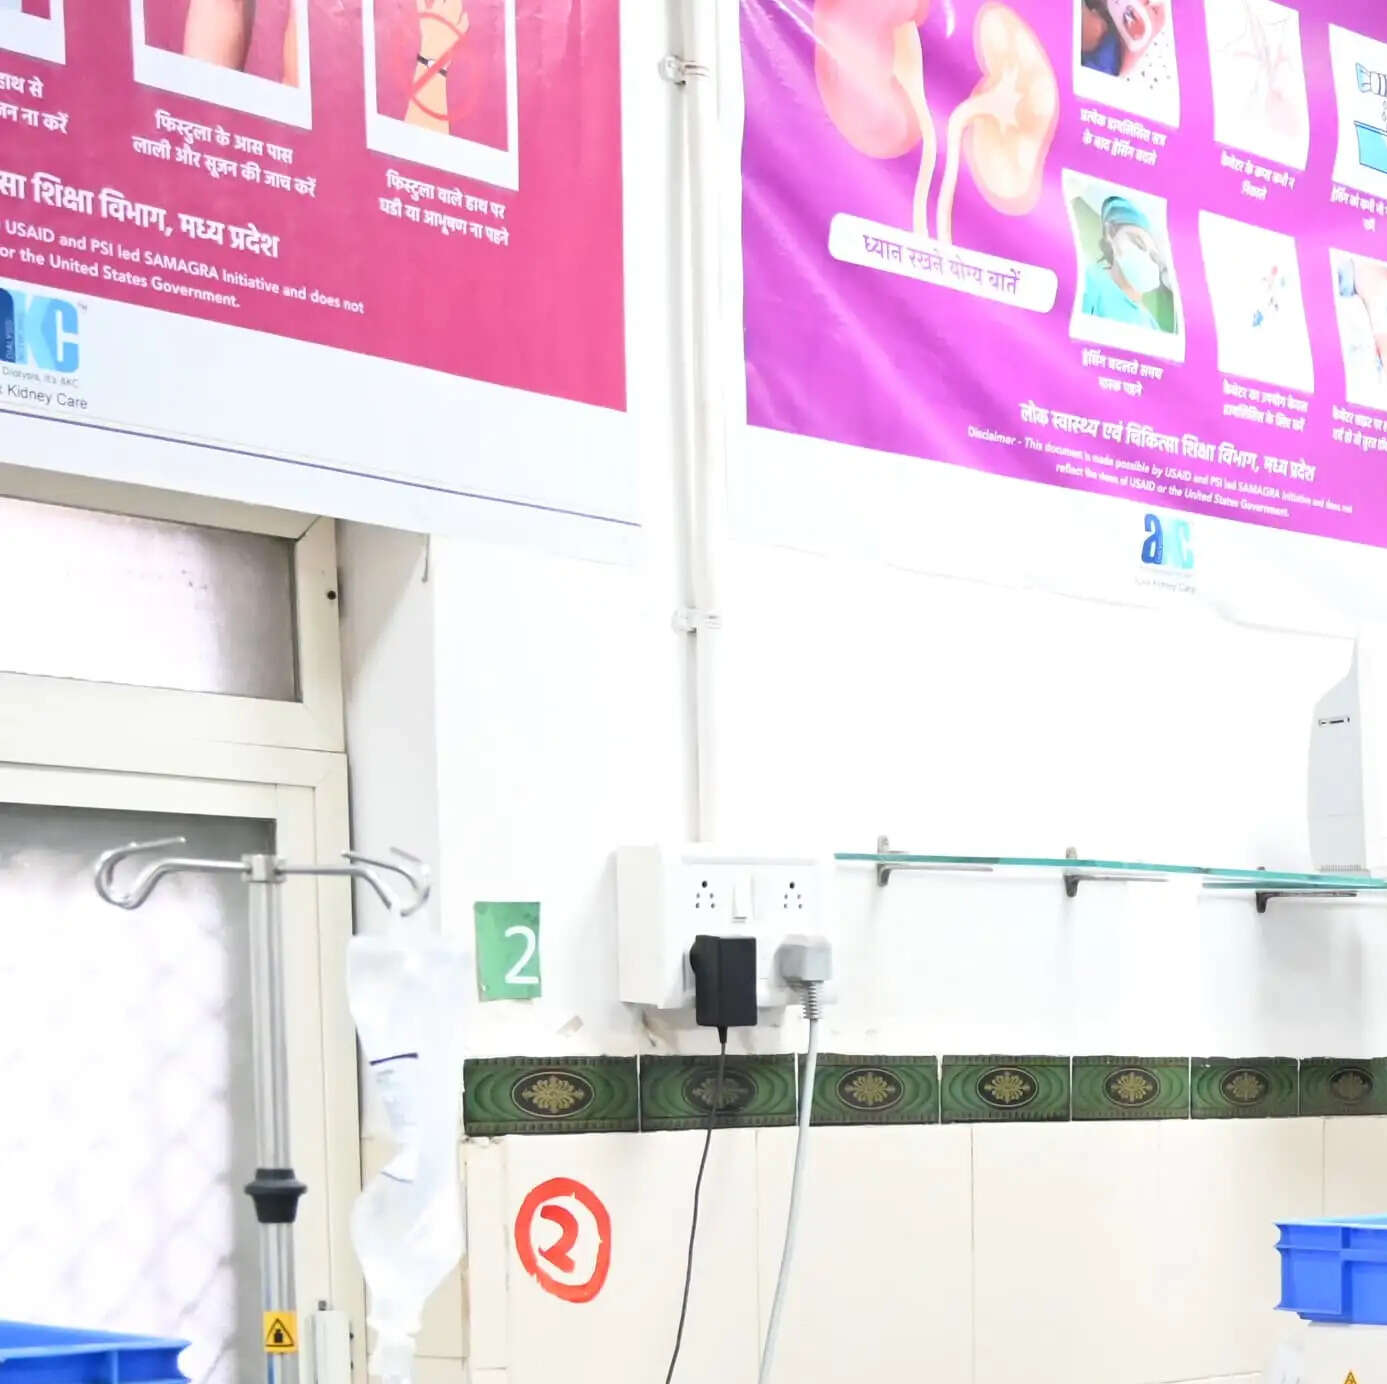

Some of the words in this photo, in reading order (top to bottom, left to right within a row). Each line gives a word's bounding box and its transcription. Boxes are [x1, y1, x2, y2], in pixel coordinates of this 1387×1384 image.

[27, 75, 44, 98] से
[20, 108, 39, 127] ना
[41, 112, 69, 134] करें
[155, 108, 211, 144] फिस्टुला
[215, 125, 230, 145] के
[234, 134, 264, 156] आस
[266, 143, 293, 164] पास
[132, 136, 171, 160] लाली
[175, 143, 201, 168] और
[204, 154, 237, 179] सूजन
[240, 161, 261, 183] की
[294, 177, 316, 197] करें
[385, 169, 434, 201] फिस्टुला
[437, 187, 462, 208] वाले
[465, 195, 488, 214] हाथ
[490, 201, 506, 219] पर
[31, 171, 94, 215] शिक्षा
[99, 187, 174, 237] विभाग,
[178, 213, 225, 245] मध्य
[228, 222, 280, 258] प्रदेश
[404, 204, 420, 222] या
[424, 209, 467, 235] आभूषण
[470, 222, 483, 238] ना
[5, 220, 55, 243] USAID
[59, 235, 87, 250] and
[90, 239, 113, 257] PSI
[118, 244, 140, 262] led
[144, 251, 219, 280] SAMAGRA
[223, 269, 279, 294] Initiative
[283, 286, 307, 300] and
[310, 290, 341, 308] does
[343, 300, 365, 314] not
[20, 248, 45, 265] the
[50, 254, 99, 277] United
[103, 265, 147, 287] States
[151, 276, 240, 308] Government.
[863, 235, 903, 262] ध्यान
[907, 247, 944, 275] रखने
[948, 253, 982, 284] योग्य
[987, 268, 1020, 295] बातें
[8, 384, 51, 405] Kidney
[56, 393, 88, 409] Care
[968, 425, 1016, 446] Disclaimer
[1025, 437, 1043, 451] This
[1044, 441, 1084, 460] document
[1115, 455, 1150, 474] possible
[1151, 464, 1163, 478] by
[1165, 467, 1192, 483] USAID
[1193, 474, 1209, 486] and
[1210, 476, 1223, 489] PSI
[1238, 481, 1280, 499] SAMAGRA
[1019, 400, 1049, 427] लोक
[1051, 411, 1100, 438] स्वास्थ्य
[1103, 420, 1123, 443] एवं
[1125, 421, 1179, 454] चिकित्सा
[1182, 434, 1217, 464] शिक्षा
[1263, 454, 1289, 477] मध्य
[1290, 458, 1316, 482] प्रदेश
[1129, 476, 1155, 493] USAID
[1157, 484, 1167, 494] or
[1168, 485, 1183, 498] the
[1184, 488, 1212, 503] United
[1214, 494, 1239, 508] States
[504, 925, 539, 984] 2
